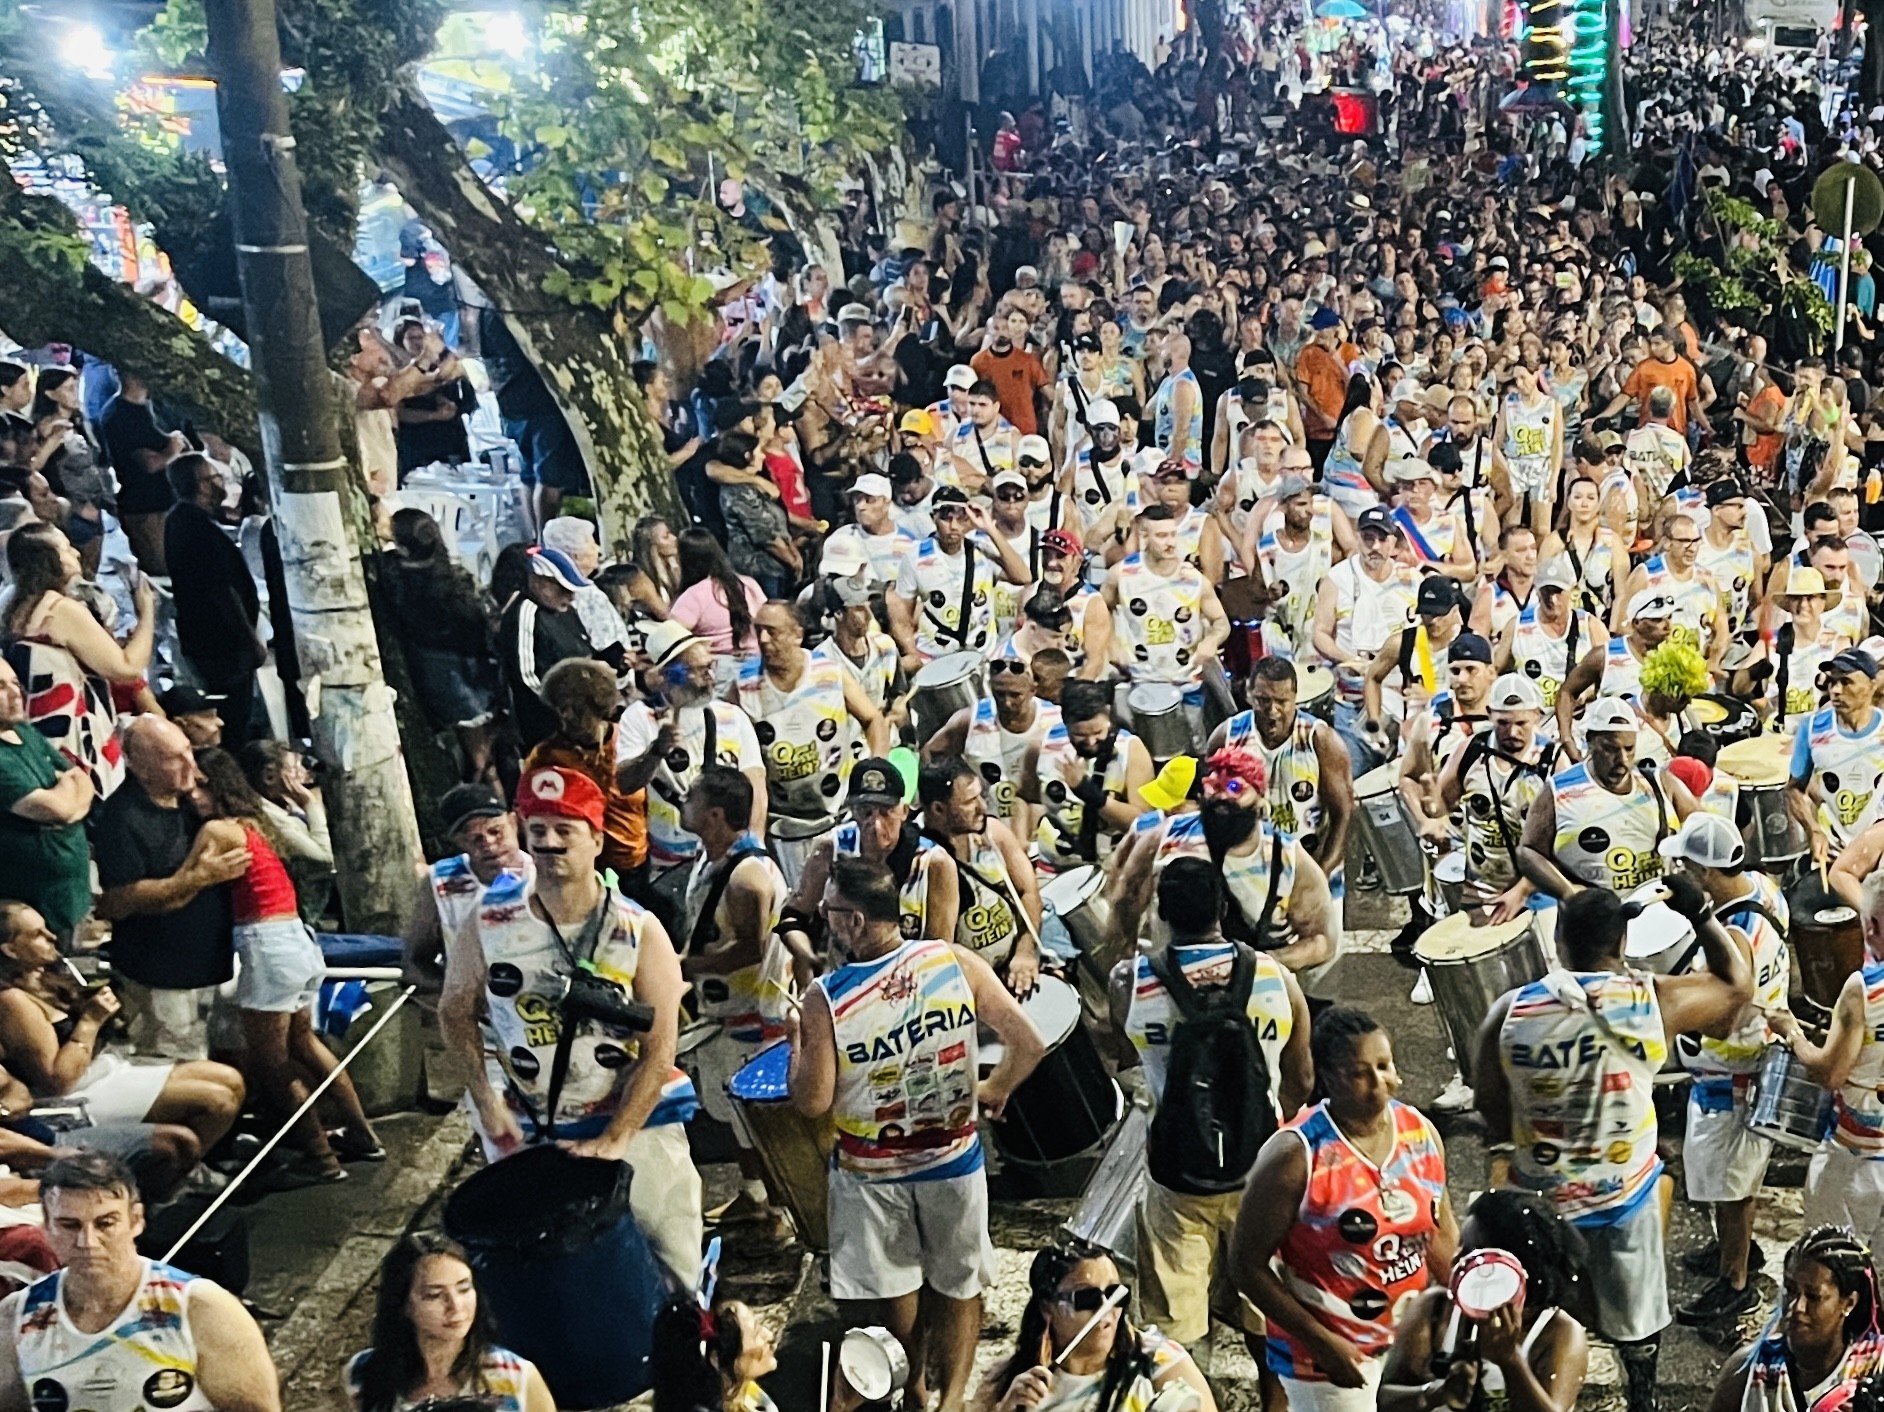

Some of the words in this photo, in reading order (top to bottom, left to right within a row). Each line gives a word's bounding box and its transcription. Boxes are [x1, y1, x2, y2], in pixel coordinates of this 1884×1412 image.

[772, 741, 794, 765] Q
[538, 779, 559, 793] M
[996, 781, 1018, 804] Q
[1836, 789, 1855, 812] Q
[1606, 847, 1636, 873] Q
[846, 1003, 976, 1064] BATERIA
[1373, 1233, 1402, 1264] Q
